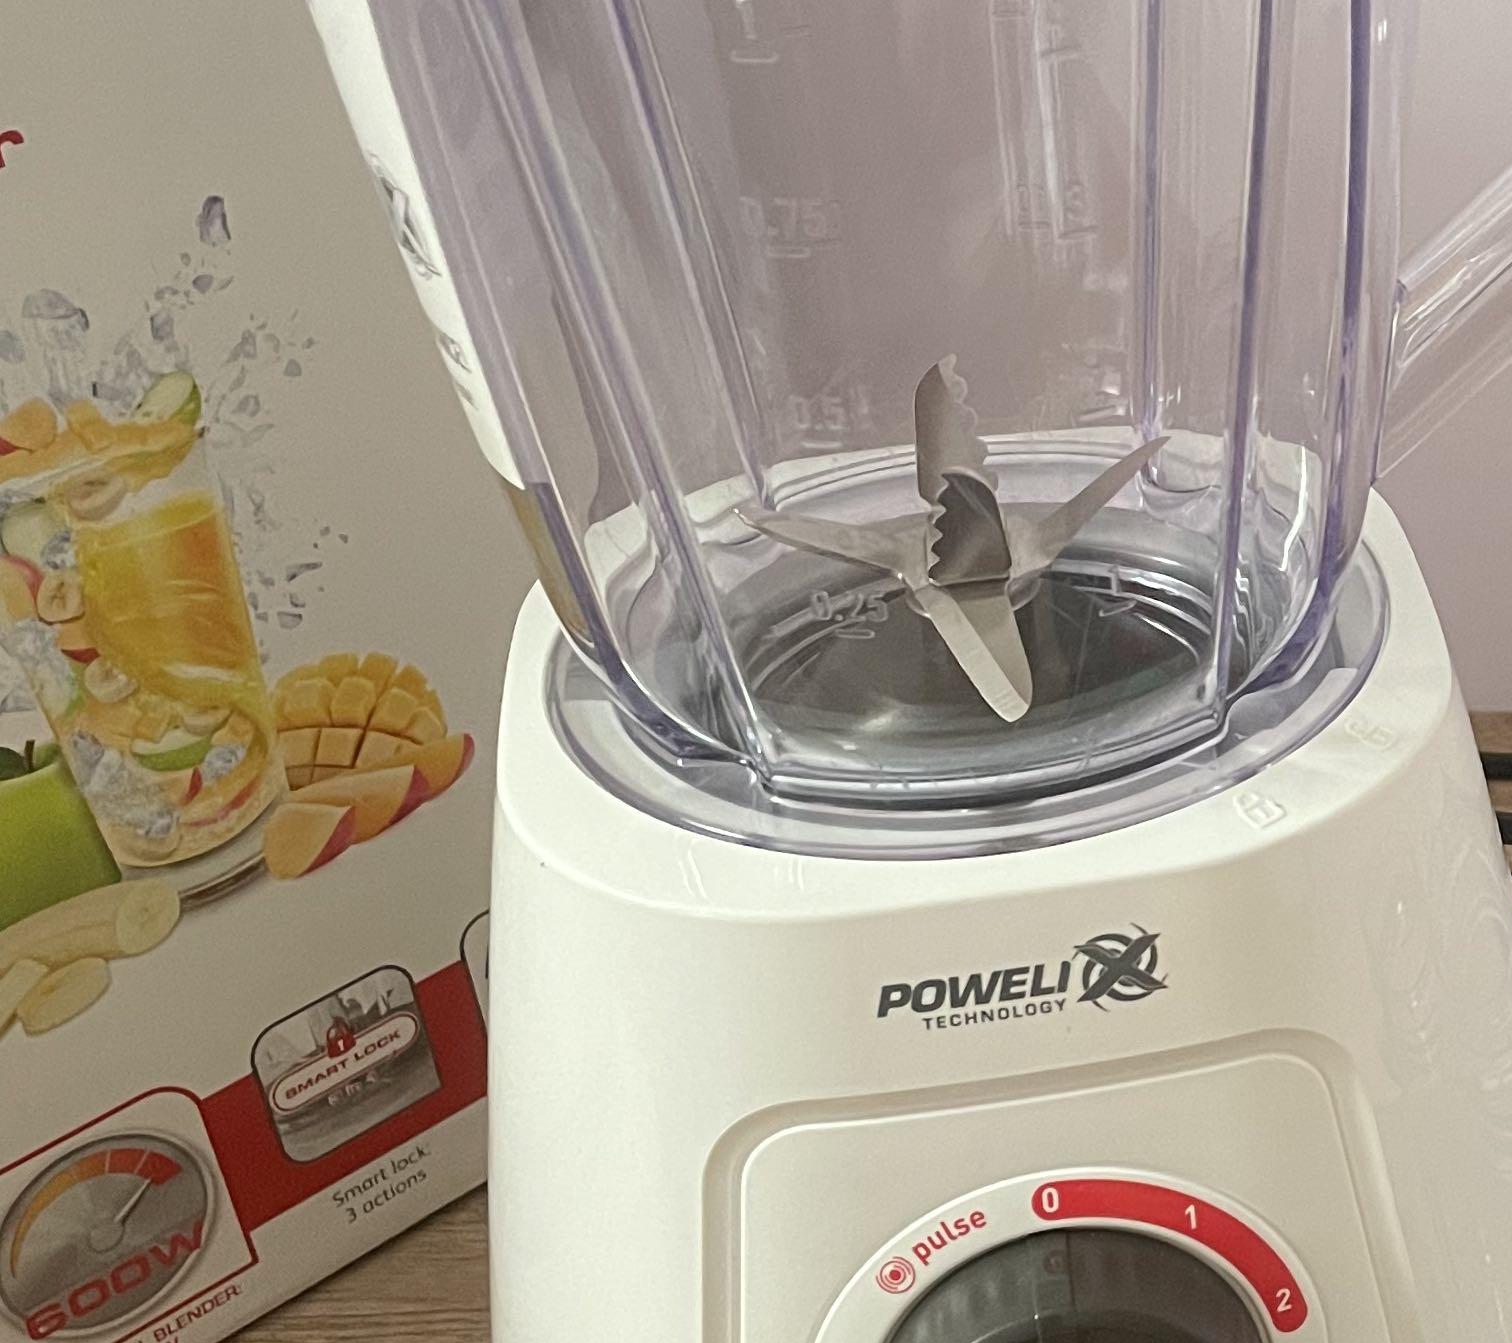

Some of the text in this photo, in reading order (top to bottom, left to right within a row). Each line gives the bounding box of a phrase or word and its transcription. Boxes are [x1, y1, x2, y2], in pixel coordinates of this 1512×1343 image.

[922, 998, 1067, 1031] TECHNOLOGY
[285, 1056, 350, 1100] SMART
[353, 1029, 402, 1062] LOCK
[332, 1168, 387, 1208] Smart
[345, 1169, 427, 1224] 3 actions
[911, 1209, 988, 1266] pulse
[1040, 1187, 1292, 1313] 0 1 2
[26, 1220, 204, 1341] 600W
